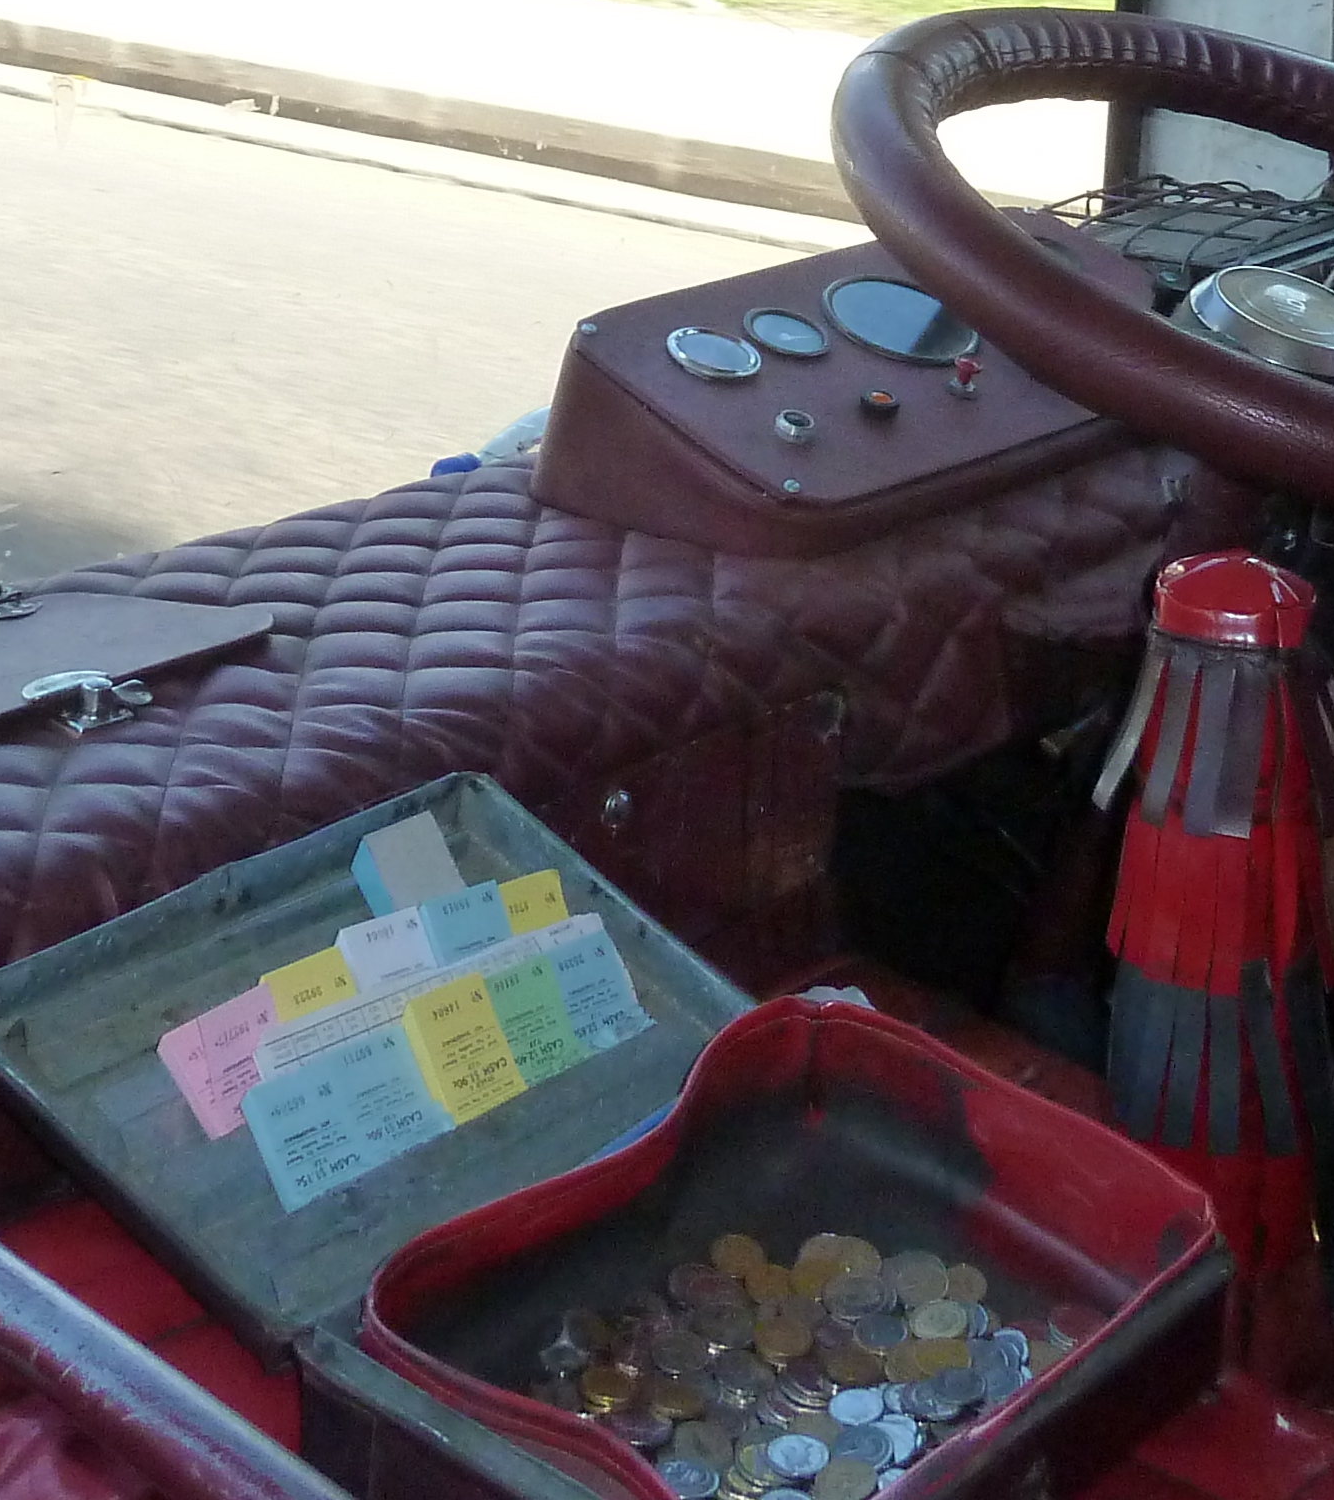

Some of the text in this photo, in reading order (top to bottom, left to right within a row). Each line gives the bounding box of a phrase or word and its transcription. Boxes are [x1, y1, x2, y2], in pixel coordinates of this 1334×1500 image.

[538, 1037, 565, 1055] CASH
[480, 1056, 509, 1076] CASH
[395, 1109, 423, 1129] CASH
[328, 1152, 361, 1173] CASH
